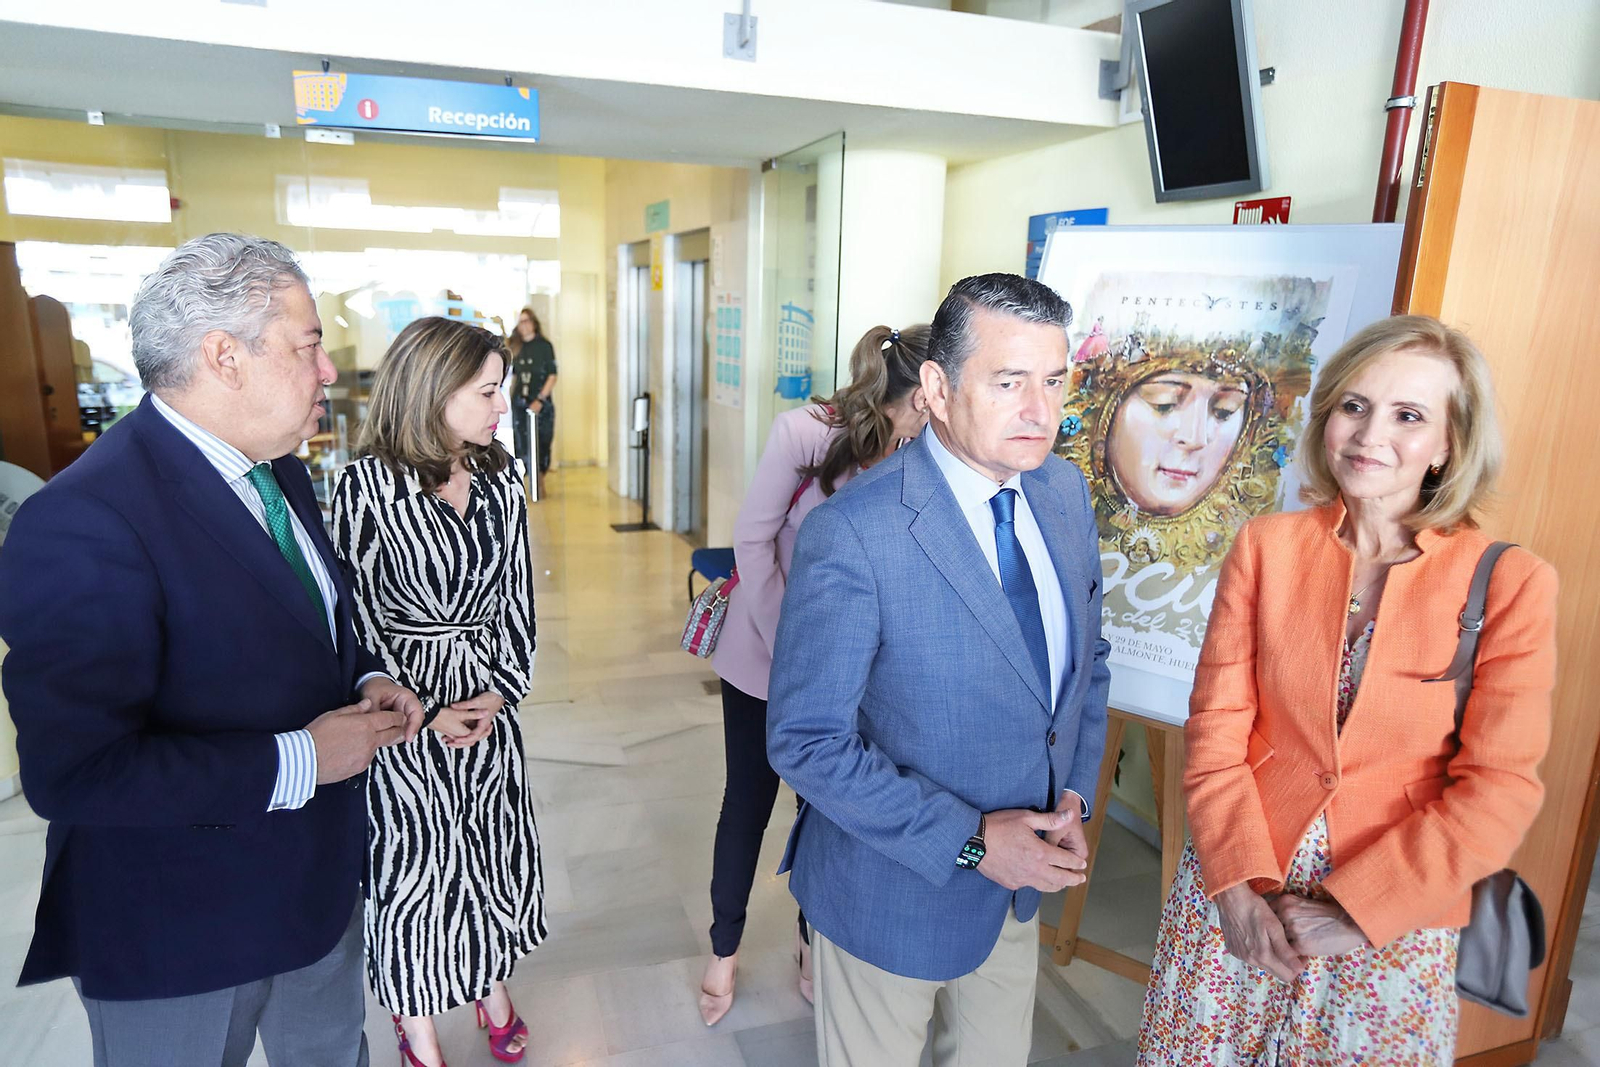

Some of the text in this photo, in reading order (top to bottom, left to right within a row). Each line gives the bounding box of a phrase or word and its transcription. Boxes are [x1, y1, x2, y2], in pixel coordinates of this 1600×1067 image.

[428, 106, 531, 131] Recepción
[1121, 296, 1278, 311] PENTECSTES
[1122, 610, 1166, 628] del
[1115, 636, 1126, 644] 29
[1127, 638, 1142, 648] DE
[1143, 641, 1173, 656] MAYO
